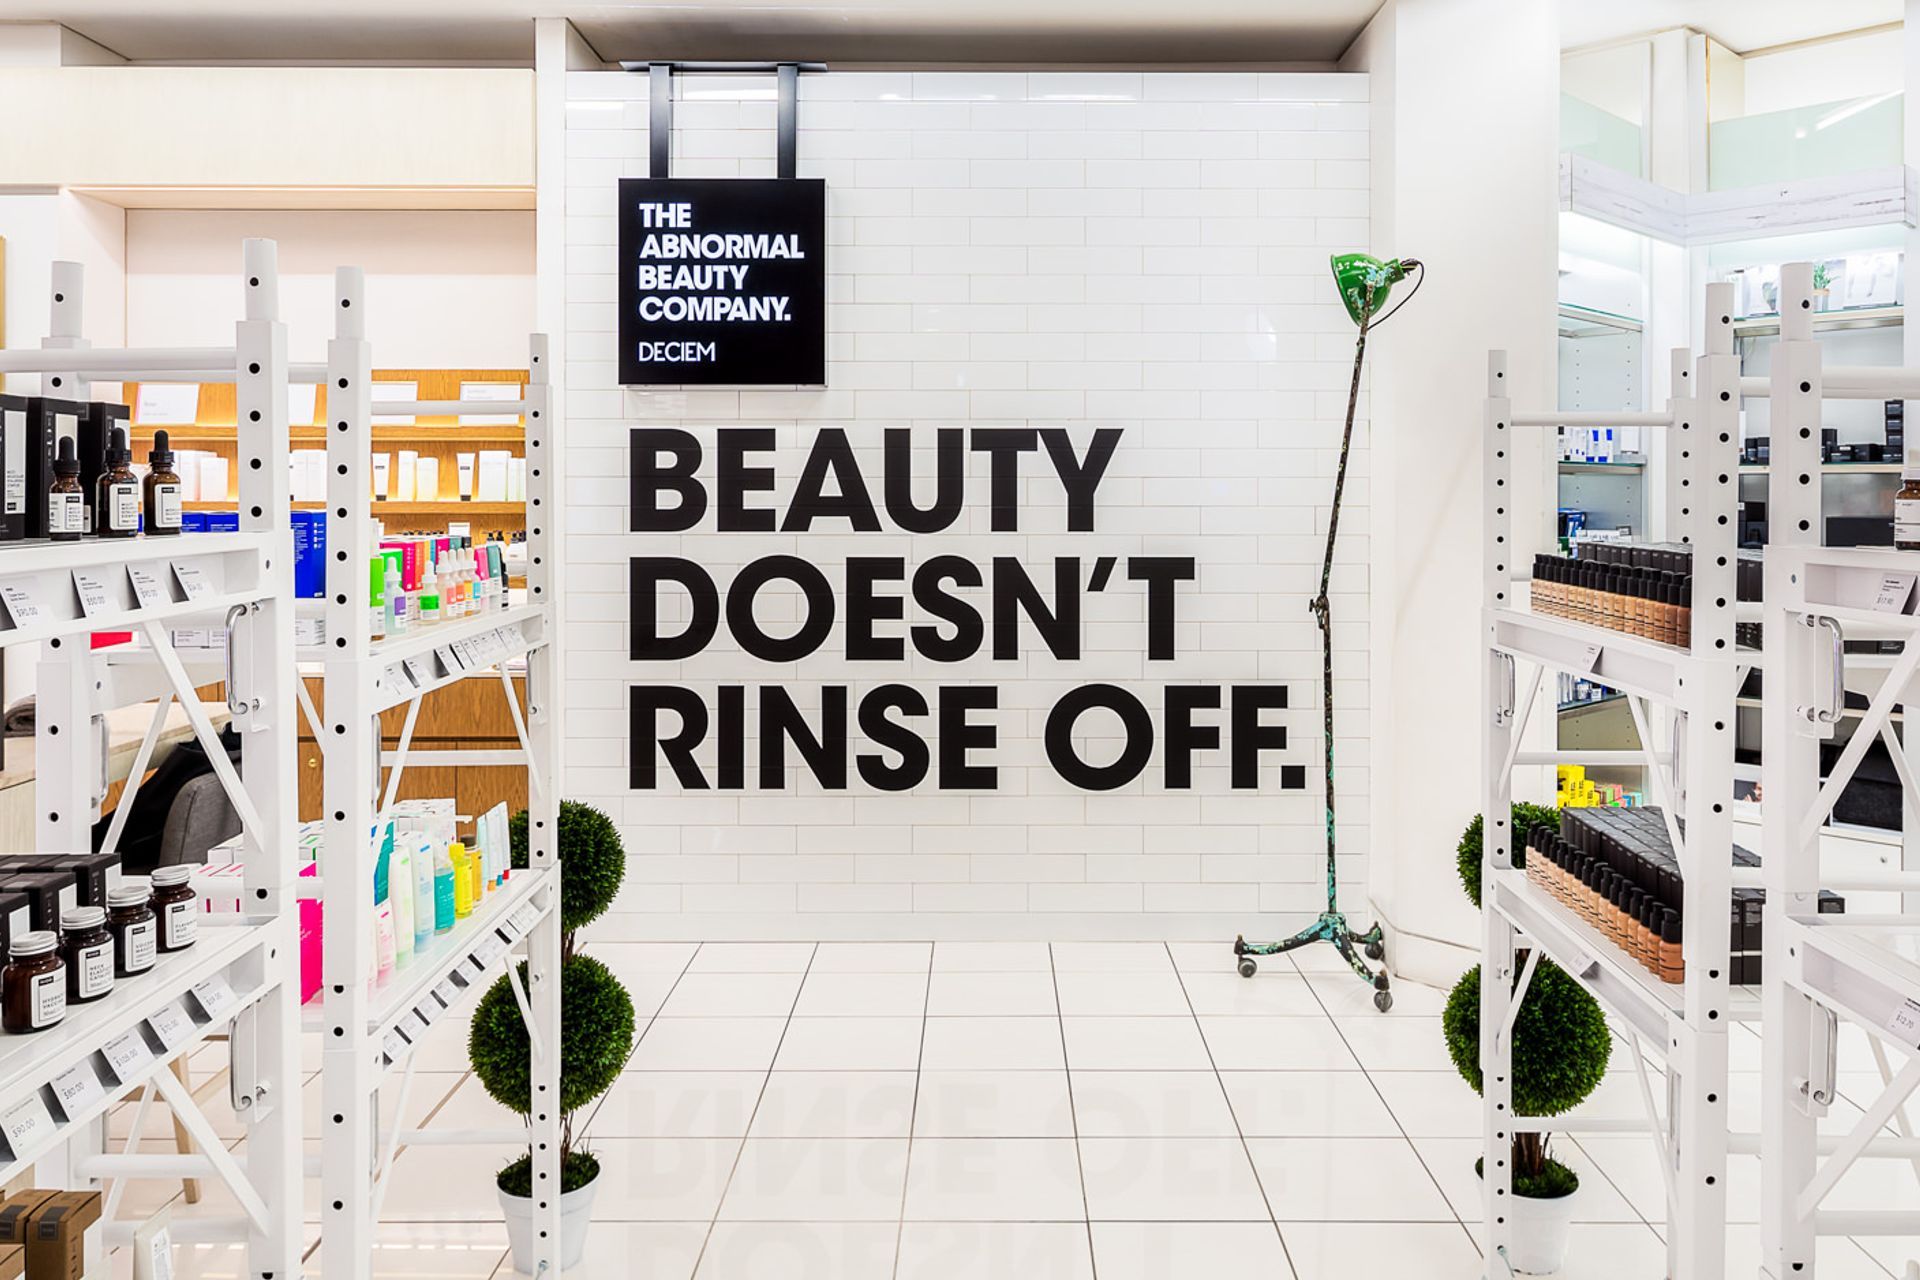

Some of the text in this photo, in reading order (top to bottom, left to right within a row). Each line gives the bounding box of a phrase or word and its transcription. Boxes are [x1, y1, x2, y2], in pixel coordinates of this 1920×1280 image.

[639, 203, 691, 227] THE
[640, 234, 804, 258] ABNORMAL
[639, 265, 748, 290] BEAUTY
[639, 297, 791, 321] COMPANY.
[639, 342, 715, 361] DECIEM
[630, 428, 1124, 533] BEAUTY
[630, 555, 1194, 662] DOESN'T
[630, 684, 1305, 791] RINSE OFF.
